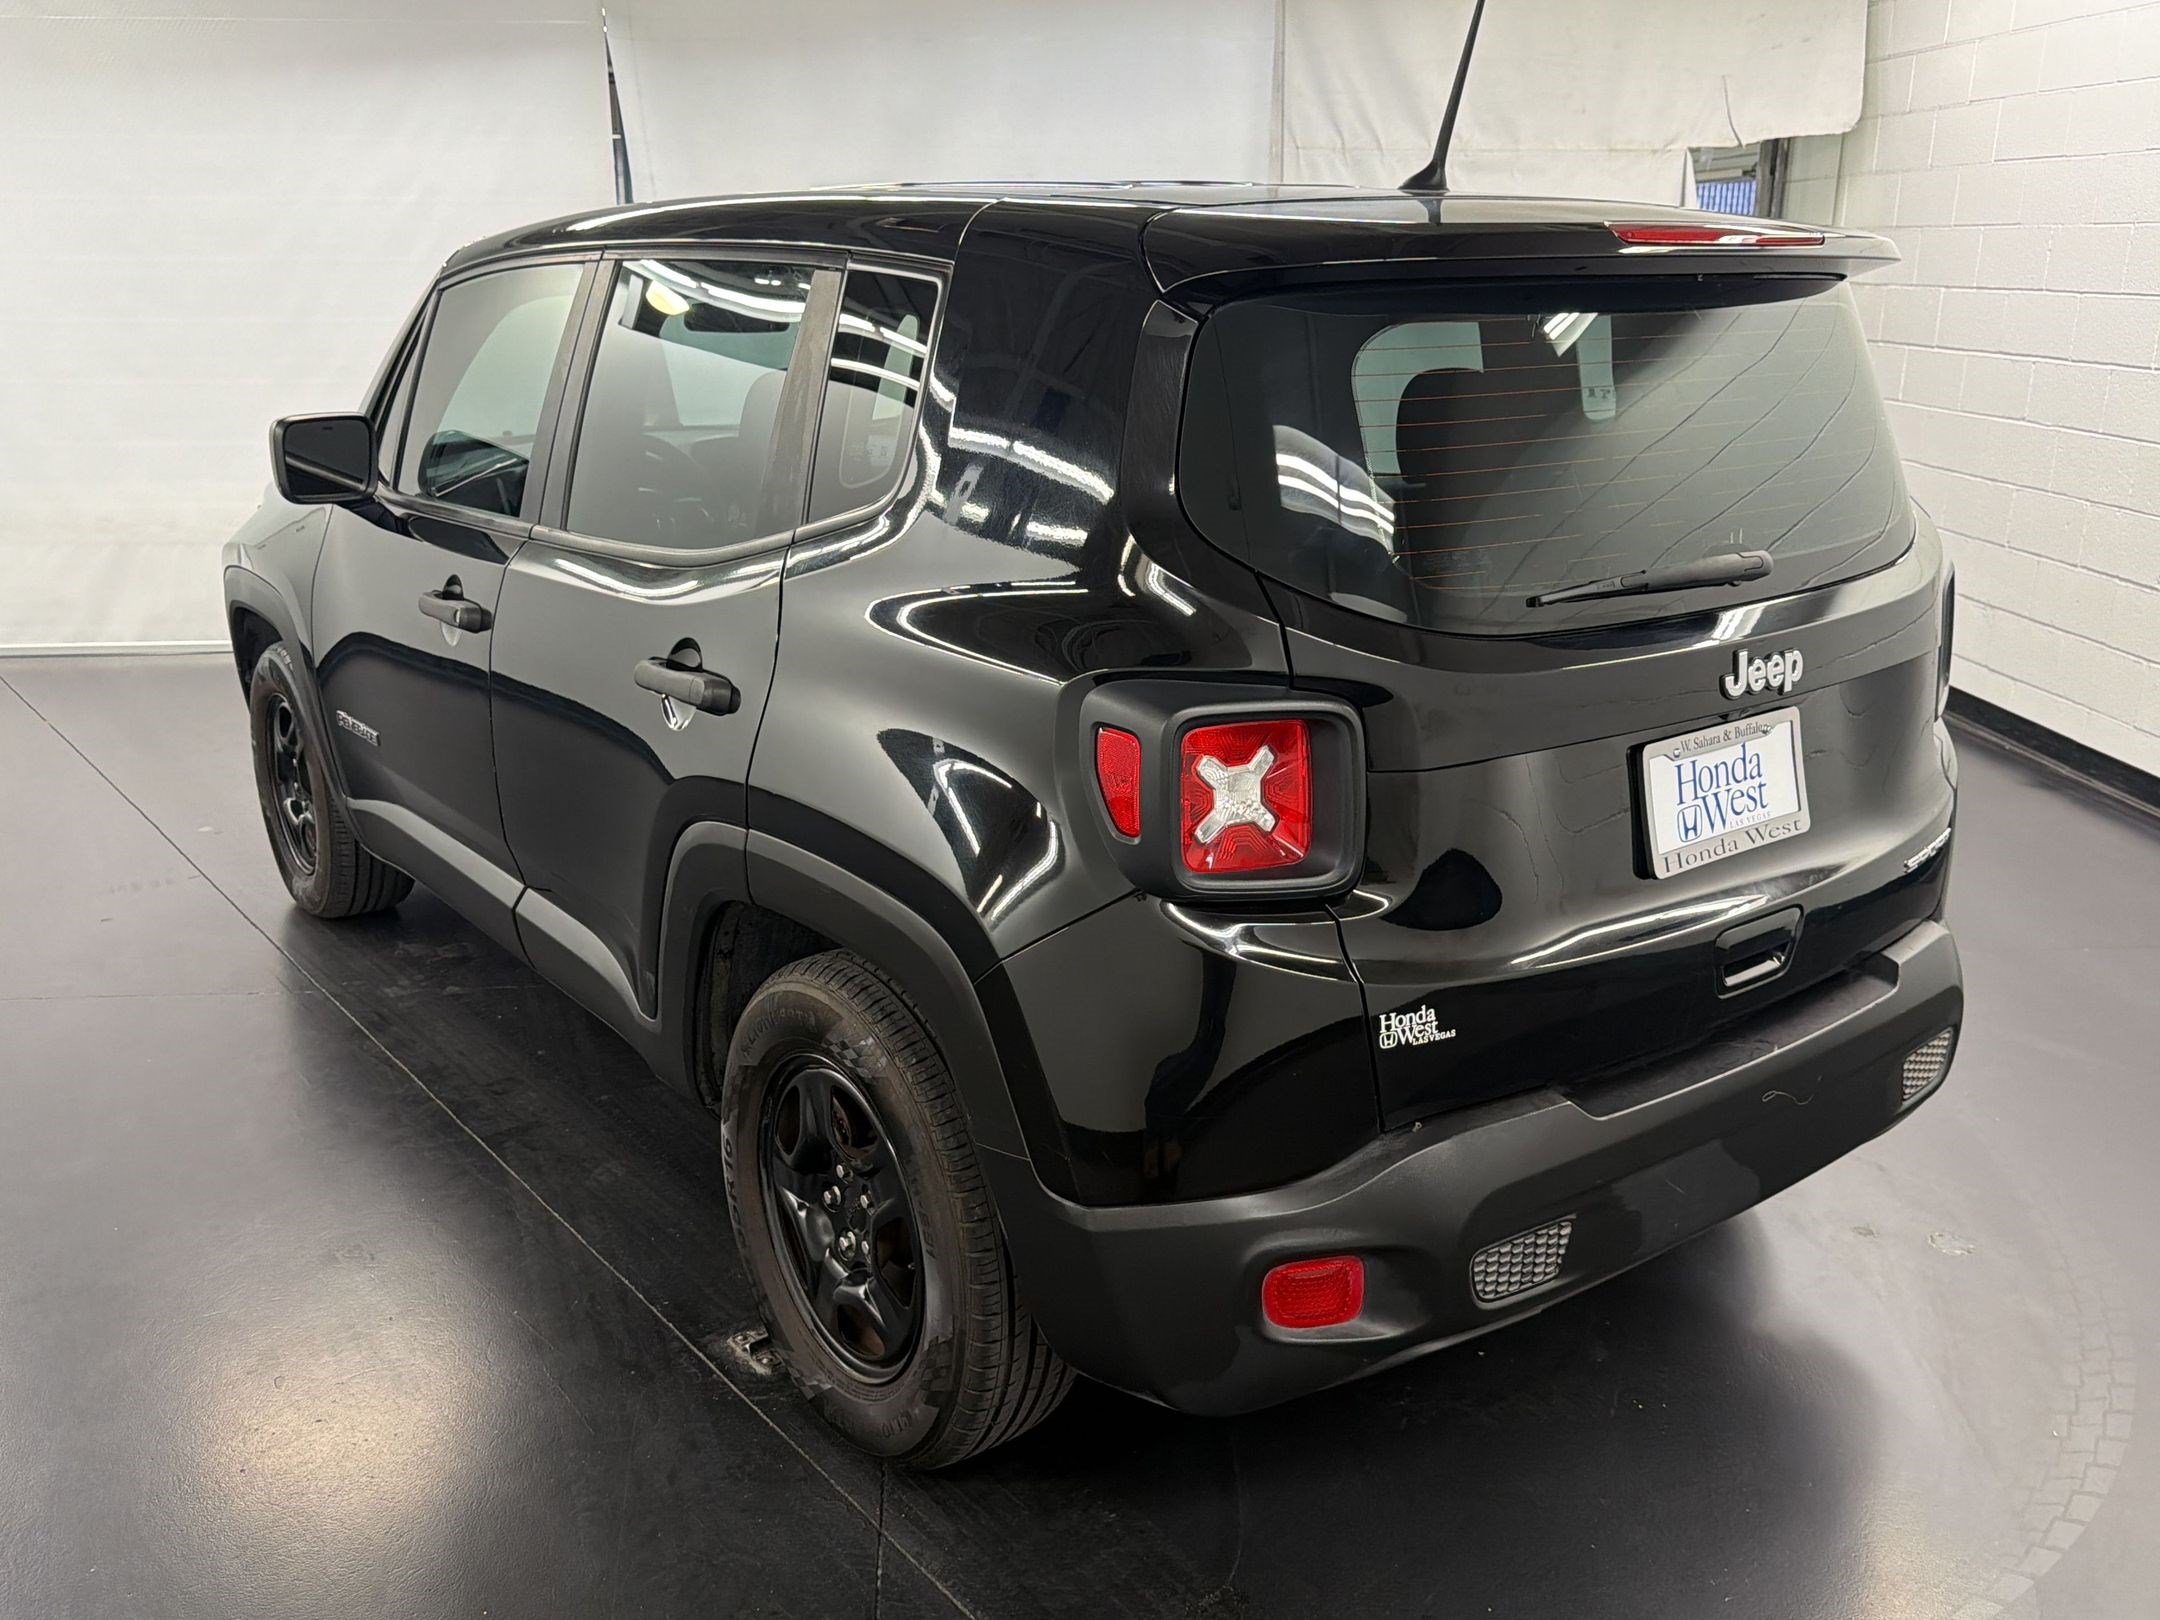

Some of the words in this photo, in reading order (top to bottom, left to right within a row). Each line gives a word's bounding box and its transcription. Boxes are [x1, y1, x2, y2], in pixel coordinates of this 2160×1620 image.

[1722, 649, 1803, 698] Jeep
[1693, 735, 1721, 750] Sahara
[1723, 729, 1732, 742] &
[1734, 724, 1764, 739] Buffalo
[1675, 742, 1762, 806] Honda
[1699, 782, 1768, 834] West
[1729, 818, 1745, 828] LAS
[1747, 811, 1771, 824] VEGAS
[1664, 838, 1738, 873] Honda
[1744, 819, 1802, 845] West
[1379, 1004, 1436, 1034] Honda
[1397, 1021, 1438, 1045] West
[1412, 1036, 1429, 1046] LAS
[1429, 1029, 1456, 1042] VEGAS
